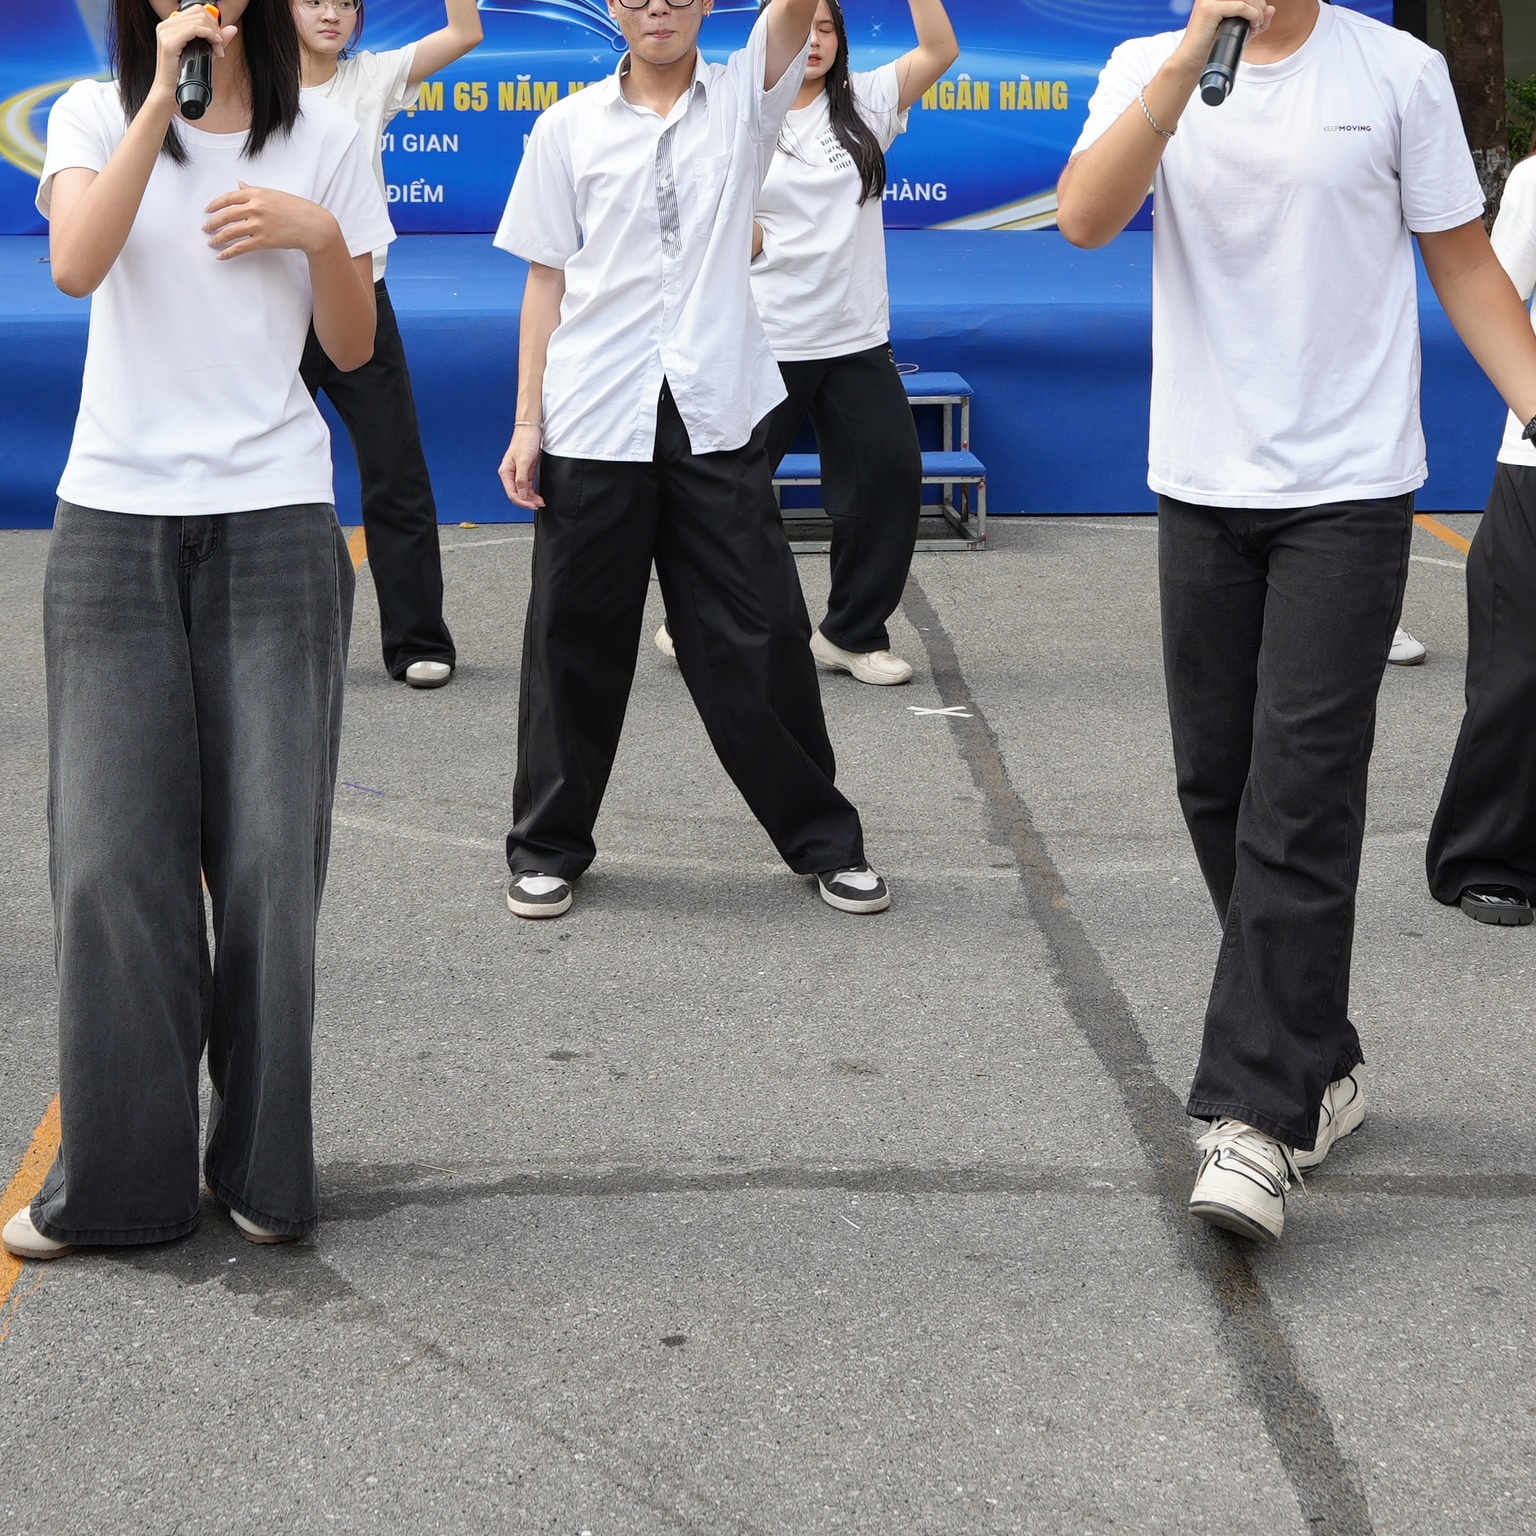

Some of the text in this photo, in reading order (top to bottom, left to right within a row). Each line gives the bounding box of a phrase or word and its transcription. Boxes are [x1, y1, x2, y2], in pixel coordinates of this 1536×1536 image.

[453, 81, 488, 111] 65
[498, 74, 559, 111] NĂM
[921, 73, 1069, 110] NGÂN HÀNG
[402, 133, 459, 152] GIAN
[386, 178, 444, 203] ĐIỂM
[883, 178, 947, 201] HÀNG
